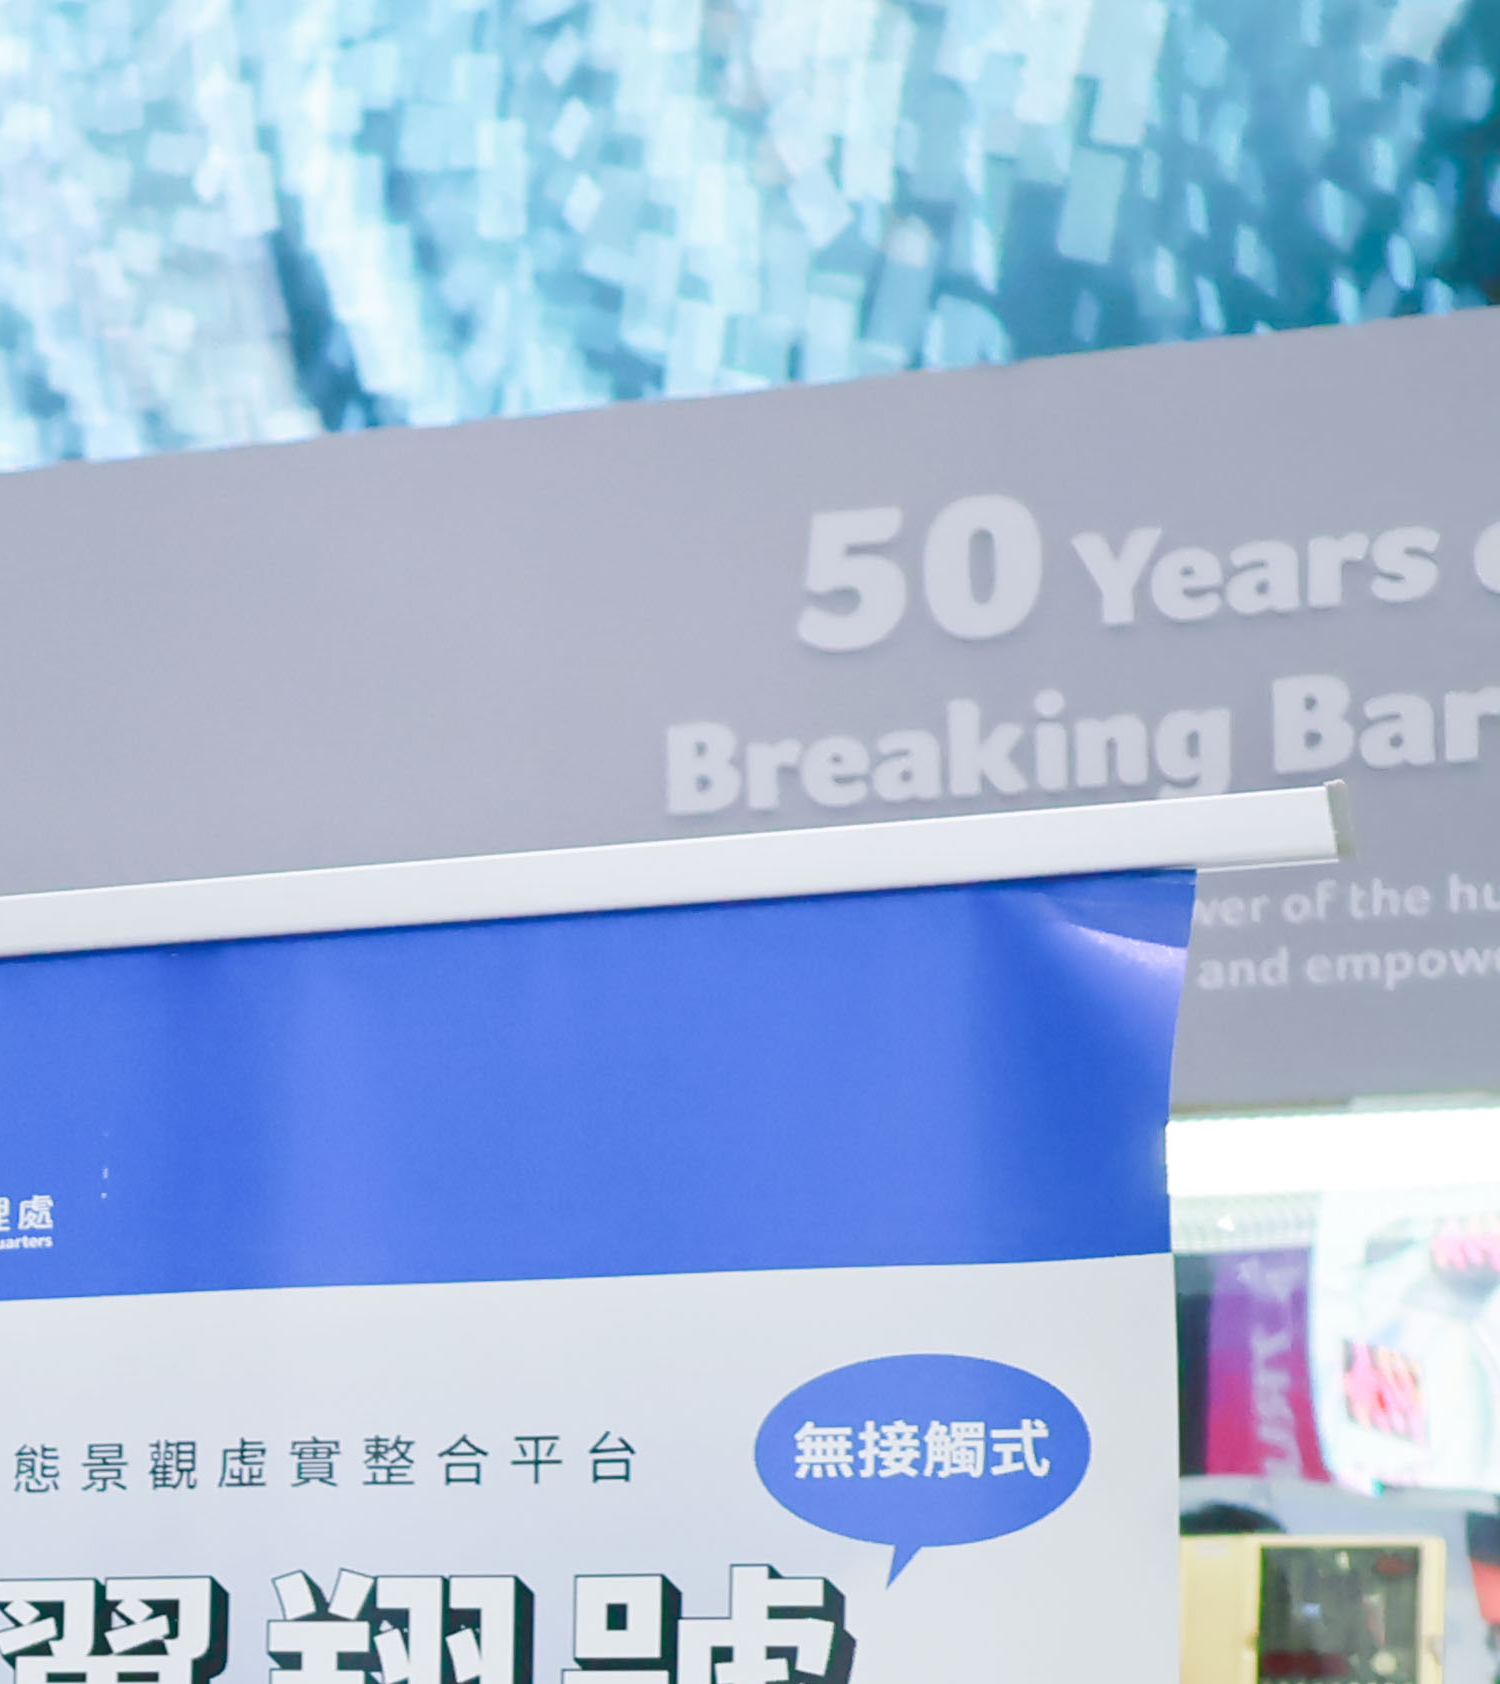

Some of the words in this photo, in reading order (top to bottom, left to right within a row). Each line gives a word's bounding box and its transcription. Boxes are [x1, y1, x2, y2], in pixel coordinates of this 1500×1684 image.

[797, 495, 1042, 652] 50
[1072, 524, 1440, 627] Years
[666, 690, 1231, 814] Breaking
[1282, 879, 1337, 924] of
[1350, 877, 1430, 920] the
[1198, 946, 1289, 990] and
[1306, 948, 1500, 991] empow
[793, 1416, 1052, 1483] 無接觸式
